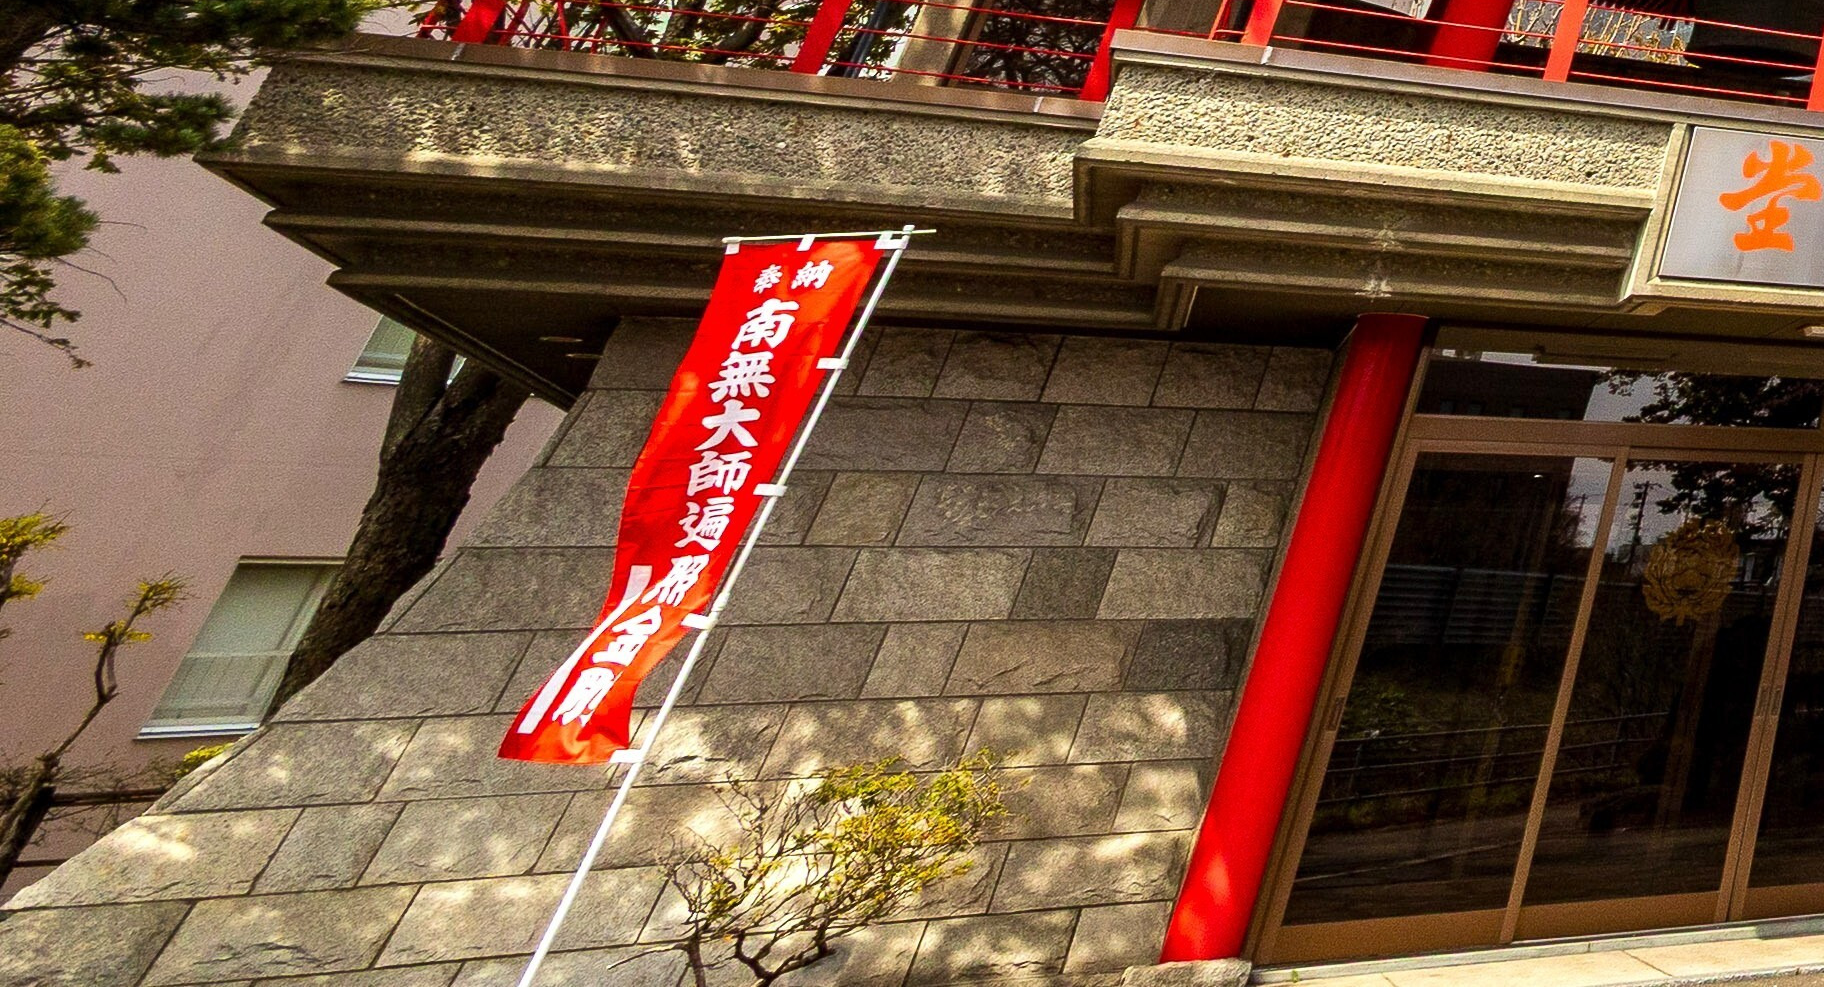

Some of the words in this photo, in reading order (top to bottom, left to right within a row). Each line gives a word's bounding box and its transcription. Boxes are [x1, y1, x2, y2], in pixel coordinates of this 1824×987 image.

[753, 259, 833, 294] 奉納
[552, 298, 799, 727] 南無大師遍照金剛
